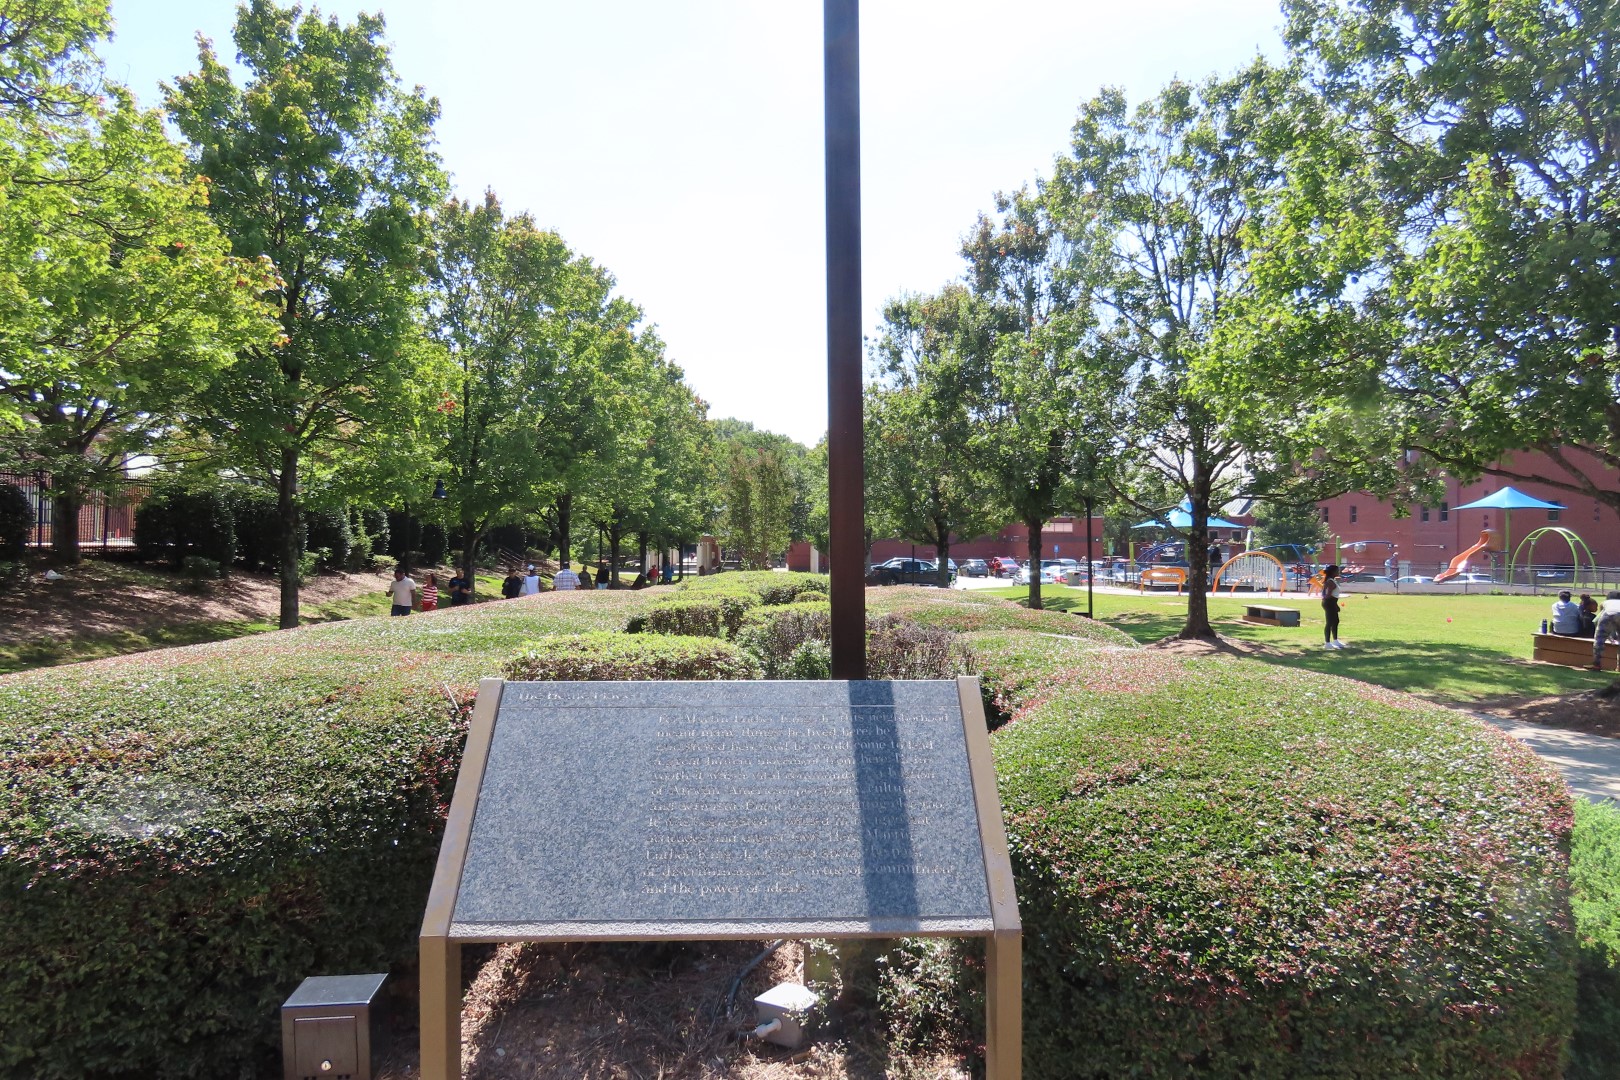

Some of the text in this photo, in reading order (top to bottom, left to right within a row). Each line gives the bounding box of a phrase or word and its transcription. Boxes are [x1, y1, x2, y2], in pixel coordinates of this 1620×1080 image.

[684, 713, 729, 723] Martin
[734, 713, 772, 723] Luther
[840, 712, 864, 722] this
[870, 711, 949, 725] neighborhood
[657, 729, 695, 738] meant
[701, 730, 734, 740] many
[787, 727, 799, 738] he
[806, 727, 837, 738] lived
[876, 725, 891, 736] he
[813, 741, 850, 751] would
[854, 741, 887, 750] come
[890, 740, 904, 750] to
[826, 755, 855, 765] from
[651, 787, 663, 796] of
[646, 849, 690, 860] Luther
[641, 883, 666, 894] and
[672, 881, 694, 894] the
[699, 884, 740, 897] power
[747, 882, 759, 894] of
